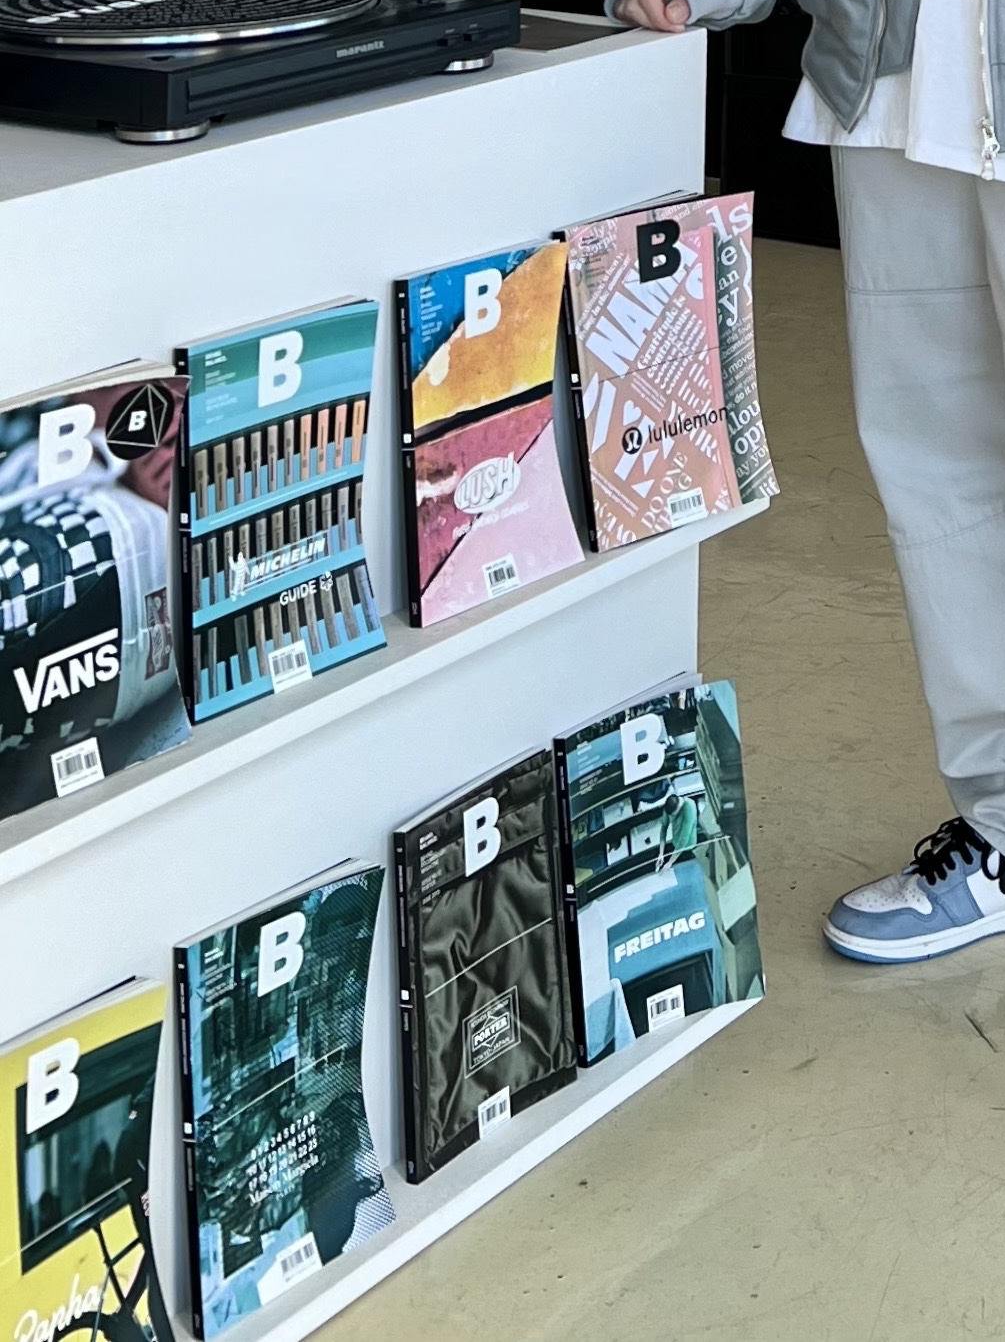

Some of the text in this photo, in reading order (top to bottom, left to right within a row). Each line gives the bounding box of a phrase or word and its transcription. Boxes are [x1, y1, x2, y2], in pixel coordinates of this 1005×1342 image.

[336, 40, 385, 59] marantz
[636, 219, 682, 285] B
[464, 268, 502, 339] B
[257, 330, 303, 408] B
[38, 403, 96, 488] B
[128, 410, 146, 432] B
[648, 406, 729, 444] lululemon
[457, 451, 515, 510] LUSH
[250, 538, 326, 580] MICHELIN
[279, 580, 317, 606] GUIDE
[13, 628, 120, 714] VANS
[620, 713, 667, 786] B
[463, 796, 502, 878] B
[257, 911, 307, 998] B
[613, 911, 705, 964] FREITAG
[474, 1016, 508, 1046] PORTER
[26, 1037, 80, 1135] B
